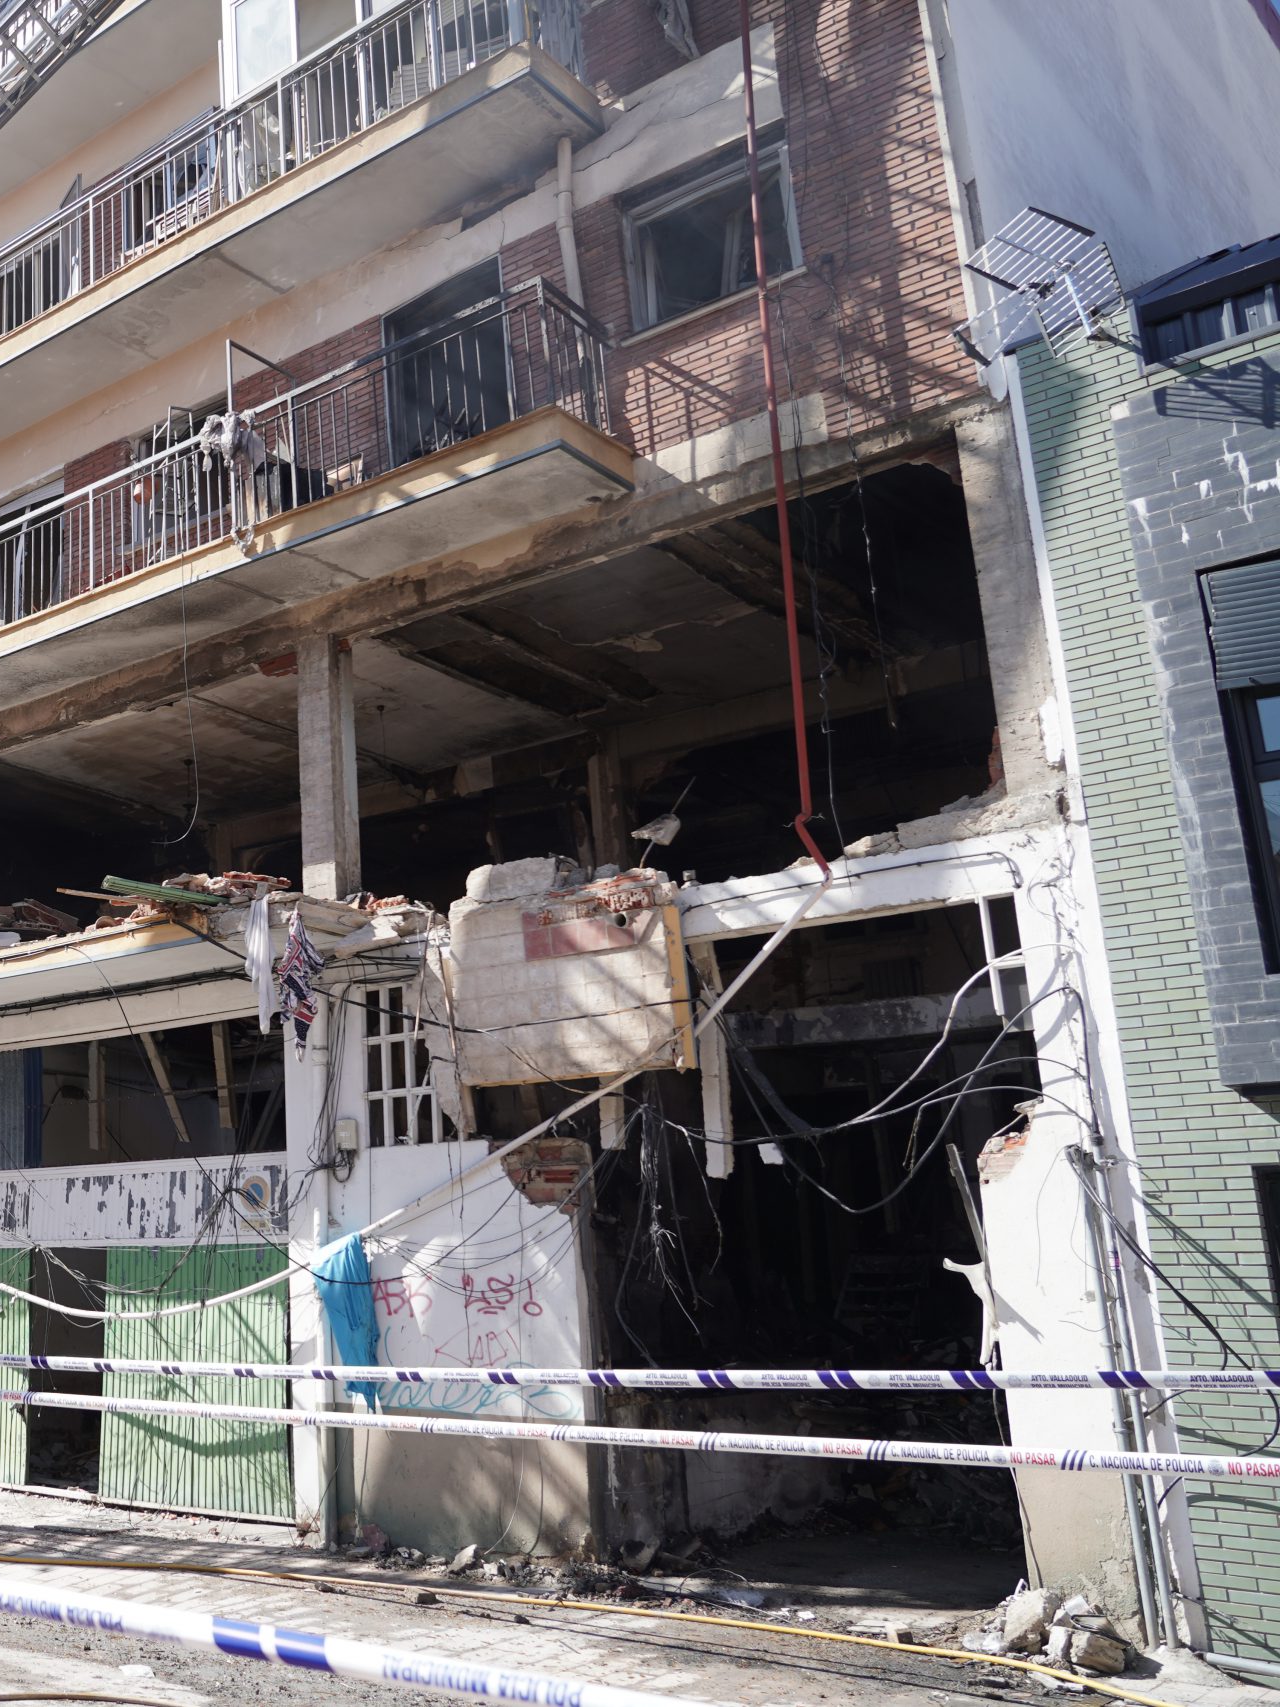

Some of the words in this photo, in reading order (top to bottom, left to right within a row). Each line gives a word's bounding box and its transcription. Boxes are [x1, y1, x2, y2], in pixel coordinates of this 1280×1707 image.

[901, 1446, 941, 1460] NACIONAL
[944, 1448, 953, 1460] DE
[957, 1449, 990, 1462] POLICIA
[1010, 1451, 1022, 1464] NO
[1026, 1452, 1056, 1466] PASAR
[1090, 1455, 1099, 1468] C.
[1101, 1456, 1148, 1470] NACIONAL
[1150, 1459, 1162, 1471] DE
[1166, 1460, 1205, 1473] POLICIA
[1228, 1462, 1242, 1475] NO
[1246, 1462, 1280, 1477] PASAR
[382, 1654, 490, 1695] MUNICIPAL
[499, 1674, 584, 1707] POLICIA
